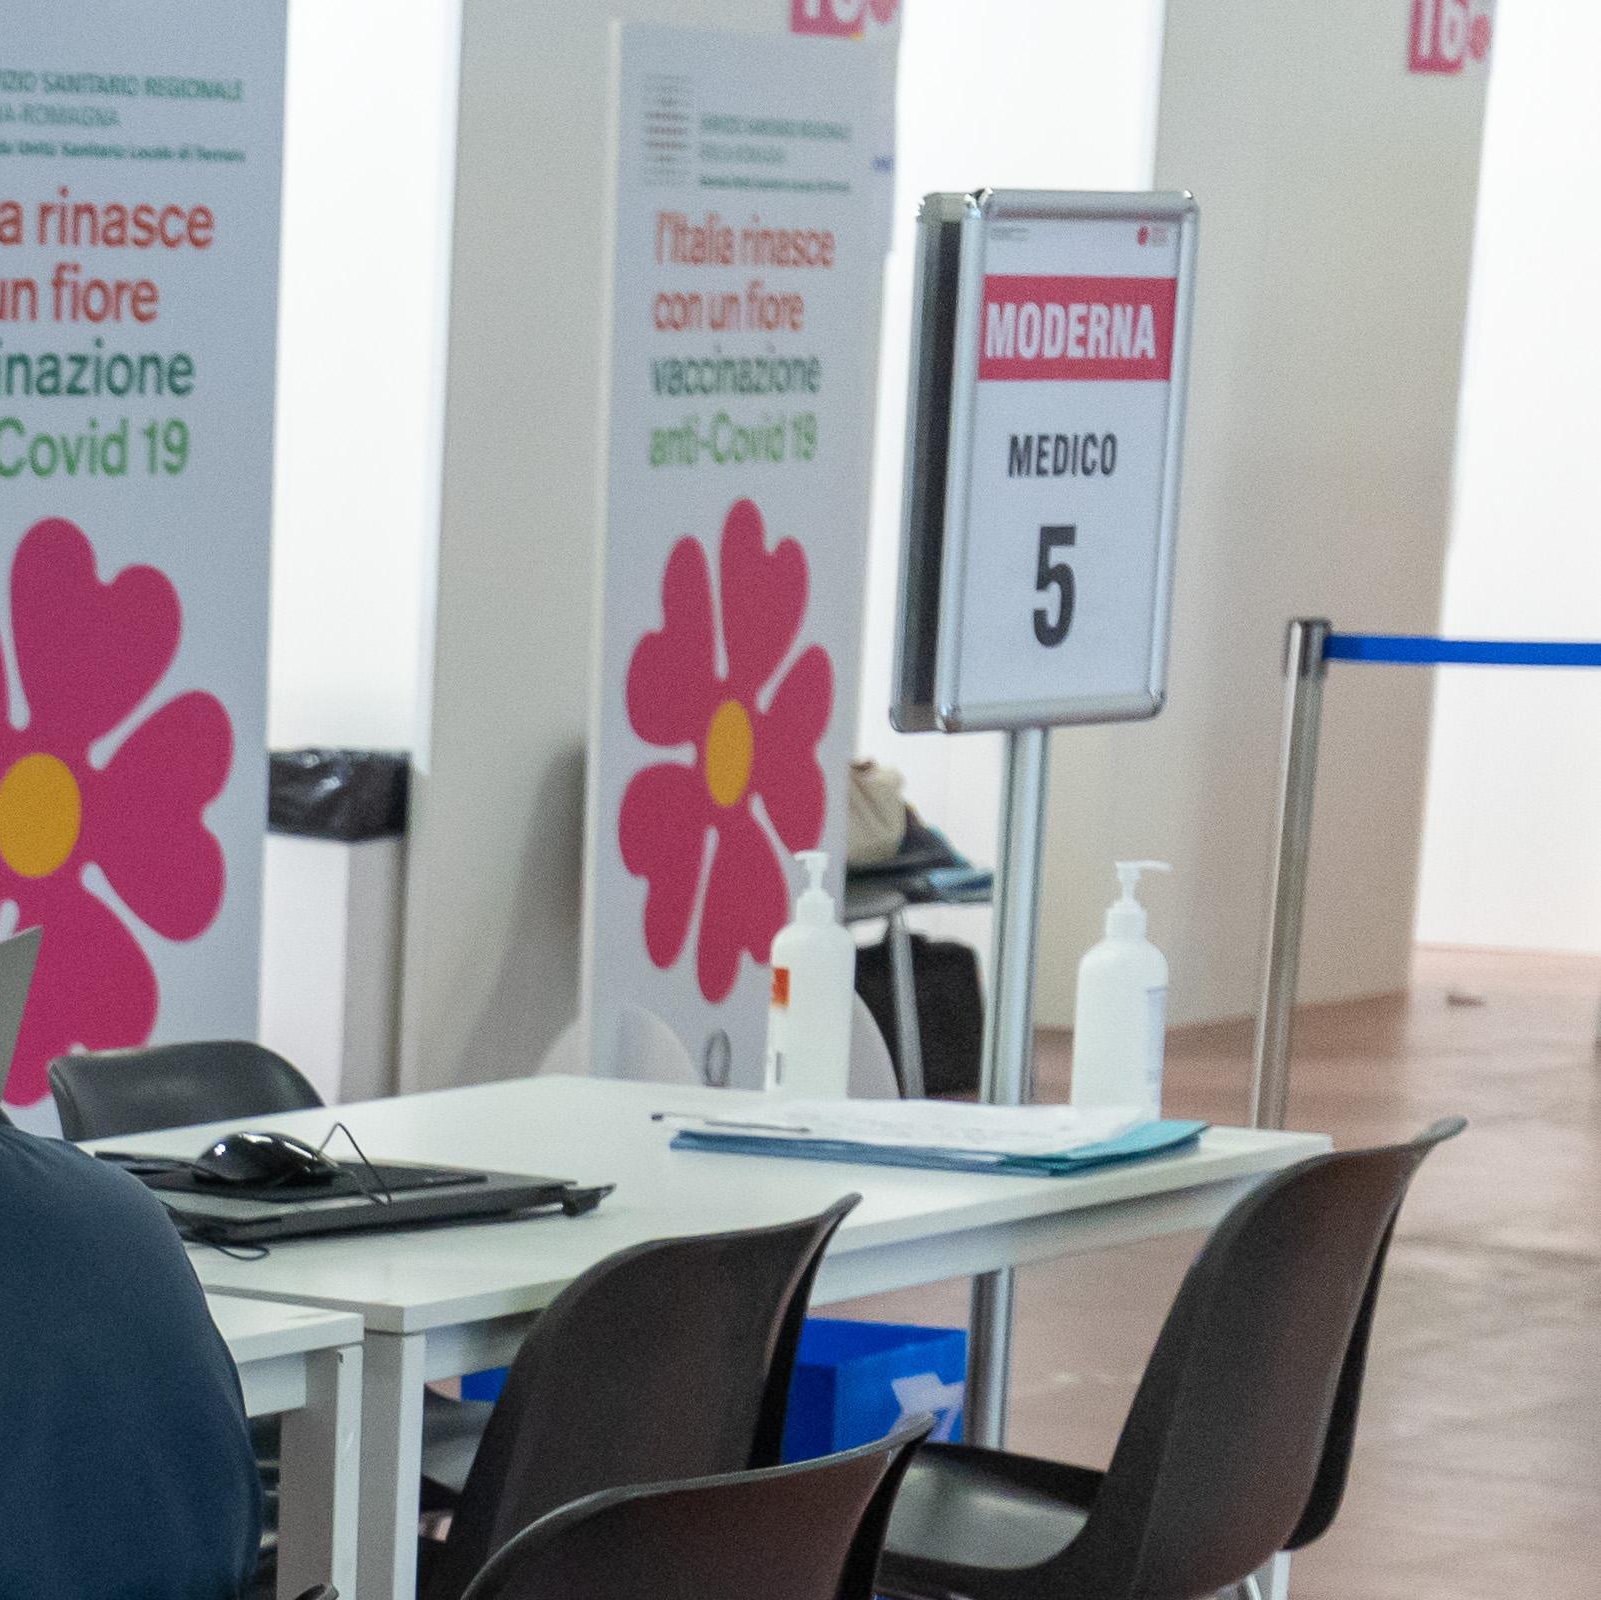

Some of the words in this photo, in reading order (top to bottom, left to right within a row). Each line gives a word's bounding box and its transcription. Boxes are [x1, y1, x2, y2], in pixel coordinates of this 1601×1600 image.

[36, 186, 215, 249] rinasce
[51, 262, 160, 324] fiore
[984, 301, 1156, 360] MODERNA
[140, 418, 190, 476] 19
[1008, 433, 1117, 477] MEDICO
[1032, 524, 1077, 648] 5
